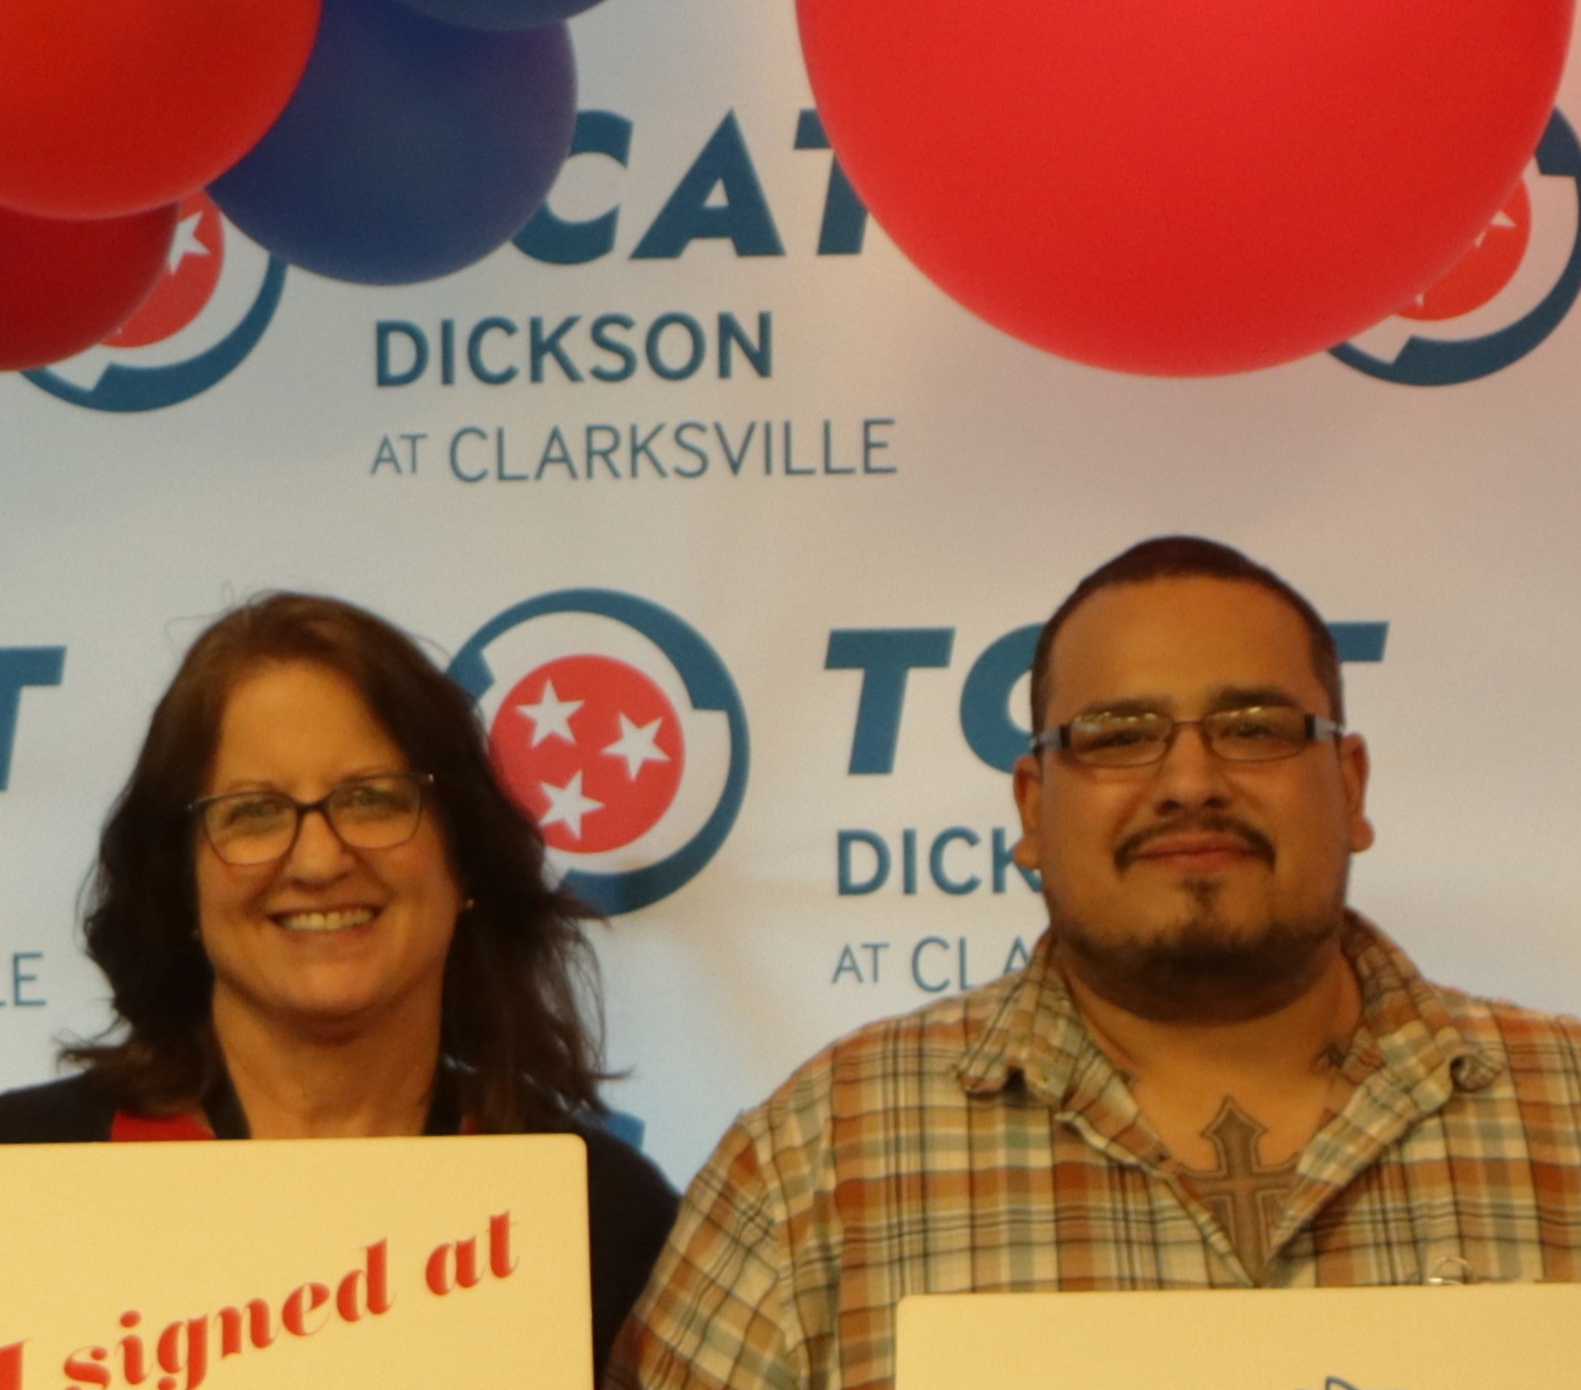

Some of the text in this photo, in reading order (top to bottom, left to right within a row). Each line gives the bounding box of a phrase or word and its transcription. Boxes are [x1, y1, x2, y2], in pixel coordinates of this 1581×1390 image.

[509, 107, 871, 265] CAT
[373, 310, 774, 388] DICKSON
[369, 418, 899, 484] AT CLARKSVILLE
[836, 825, 1042, 896] DICK
[831, 942, 890, 984] AT
[425, 1209, 520, 1297] at
